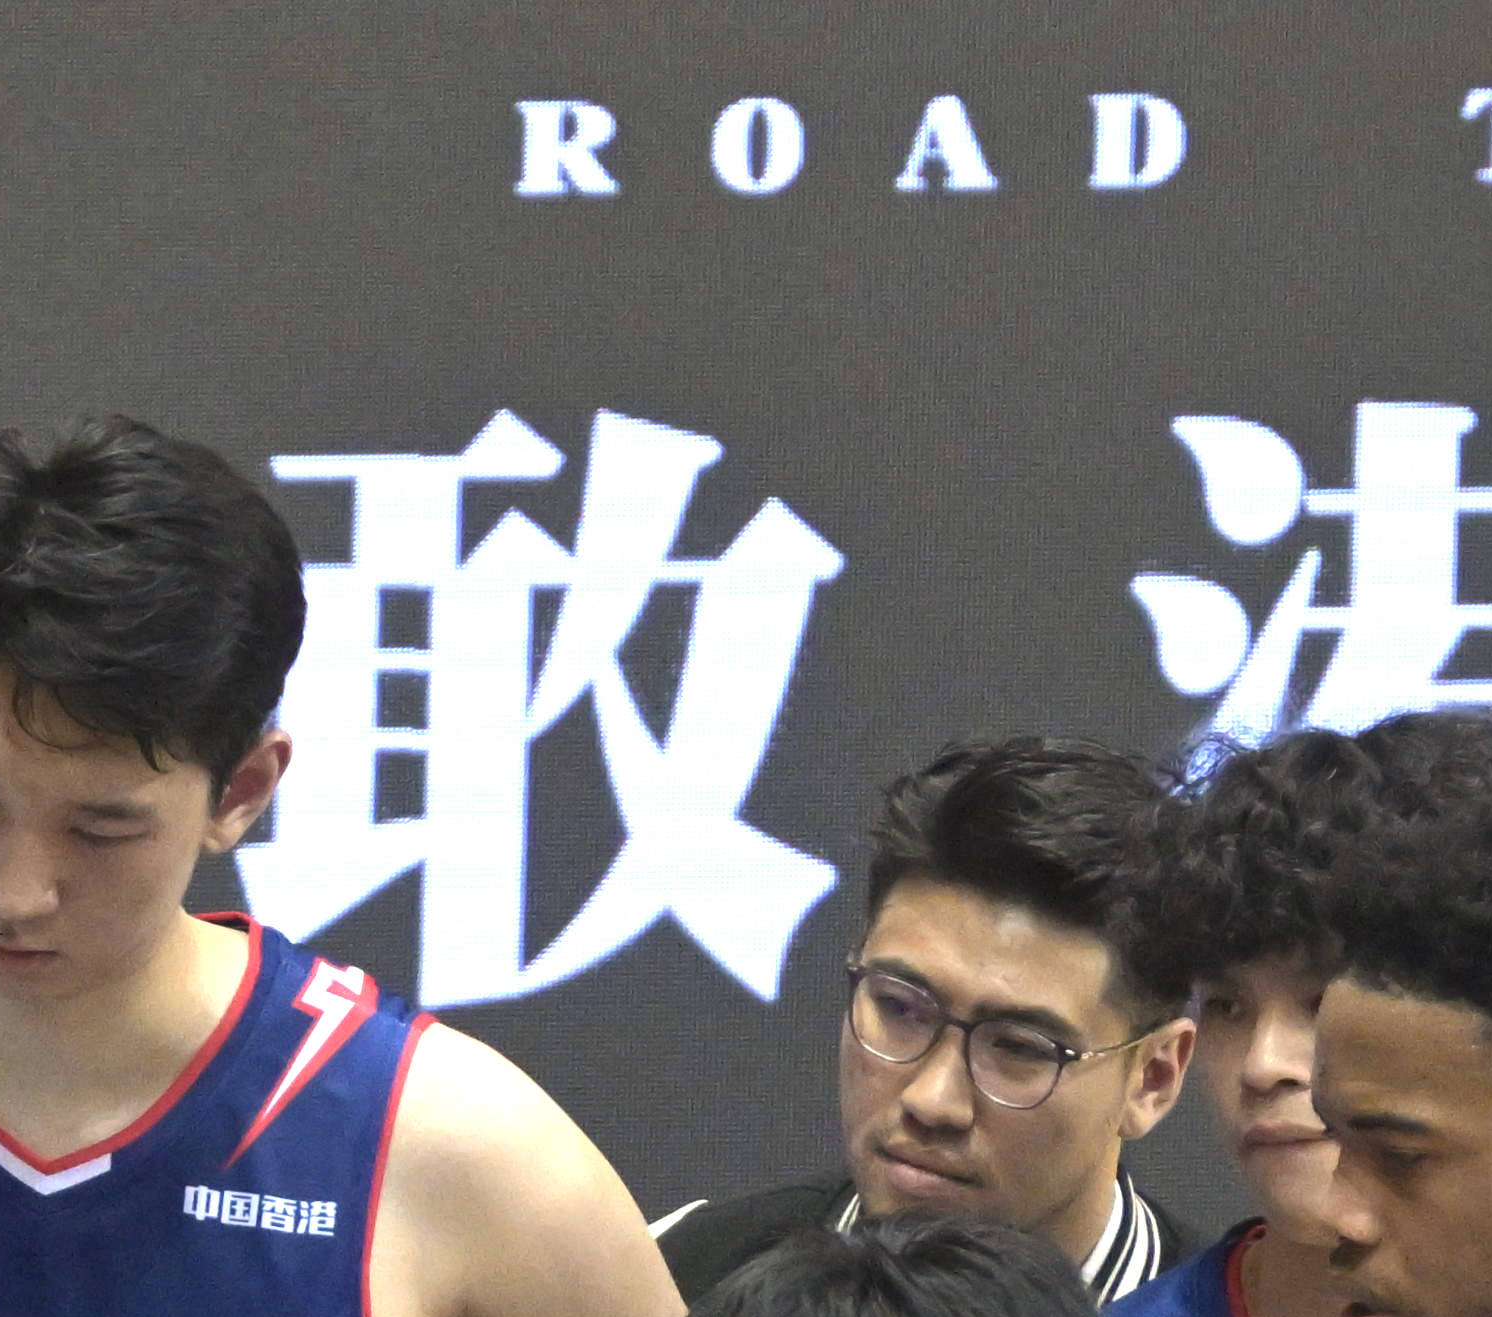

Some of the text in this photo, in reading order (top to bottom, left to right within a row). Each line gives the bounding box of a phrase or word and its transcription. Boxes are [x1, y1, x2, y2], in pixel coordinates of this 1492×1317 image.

[511, 92, 1187, 198] ROAD
[183, 1185, 338, 1236] 中国香港
